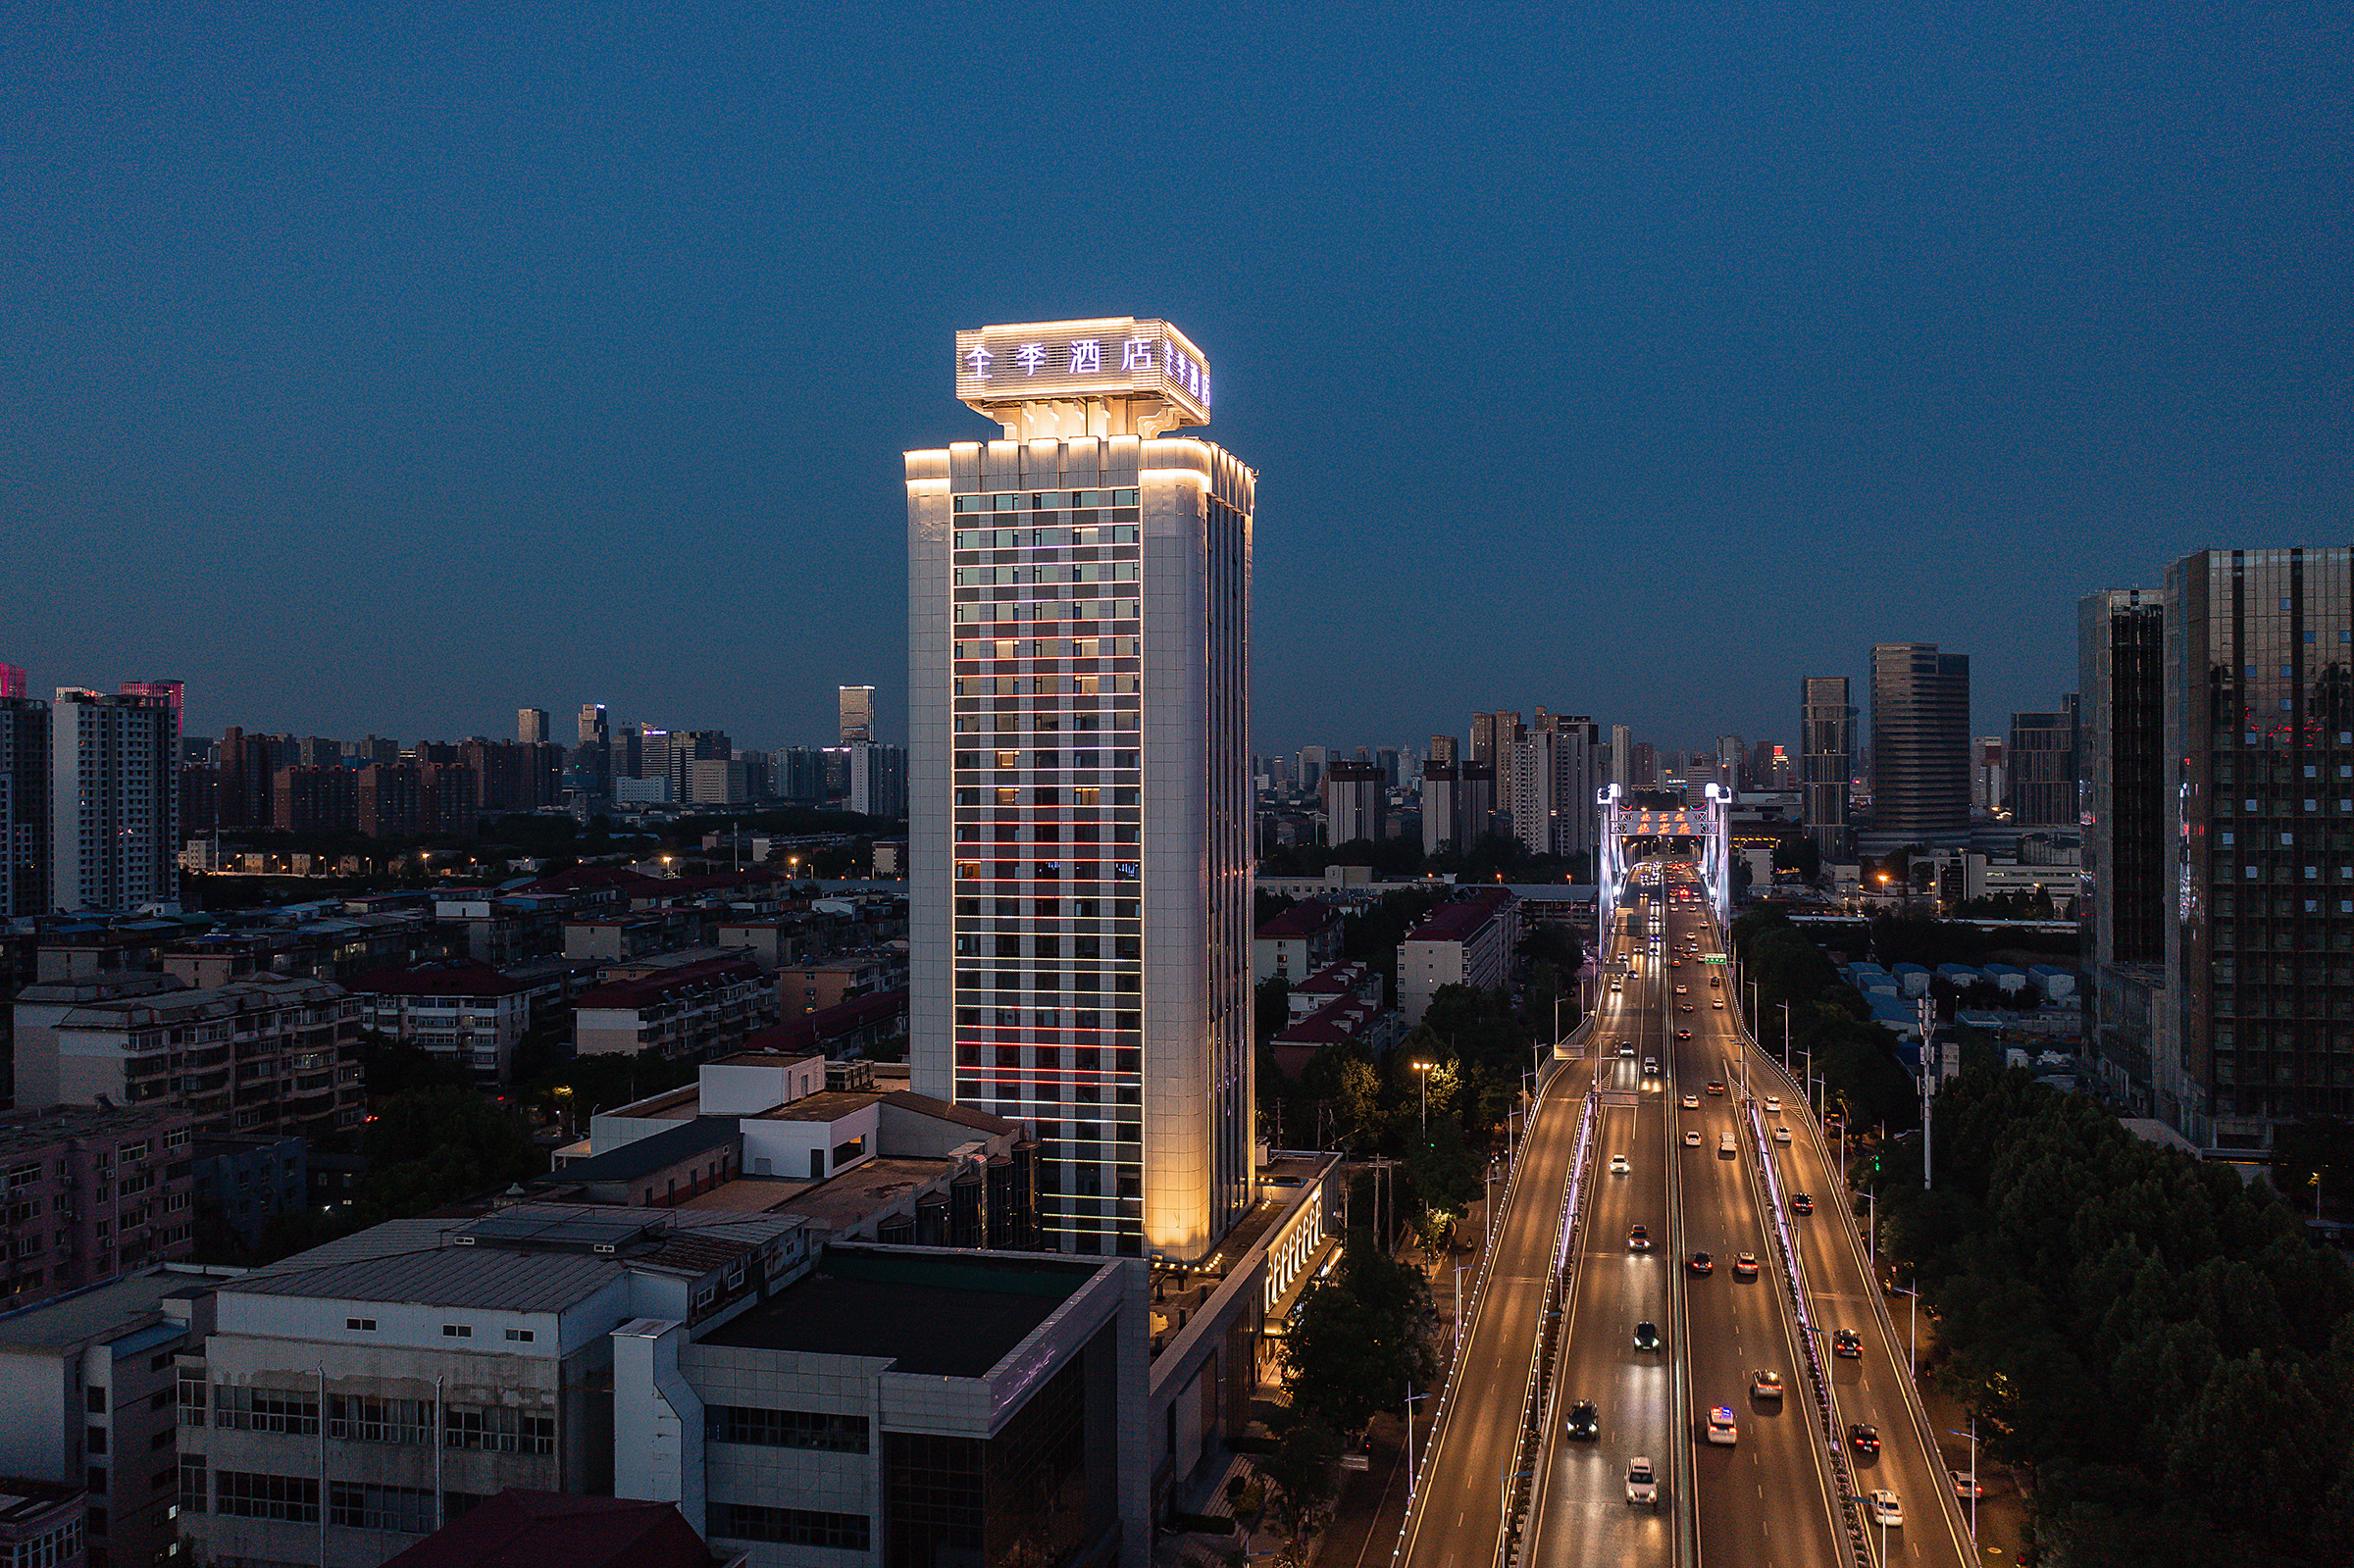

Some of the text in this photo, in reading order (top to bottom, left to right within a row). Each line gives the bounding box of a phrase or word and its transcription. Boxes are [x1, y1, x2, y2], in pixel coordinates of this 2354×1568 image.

[965, 337, 1153, 379] 全季酒店
[1163, 339, 1211, 407] 全季酒店
